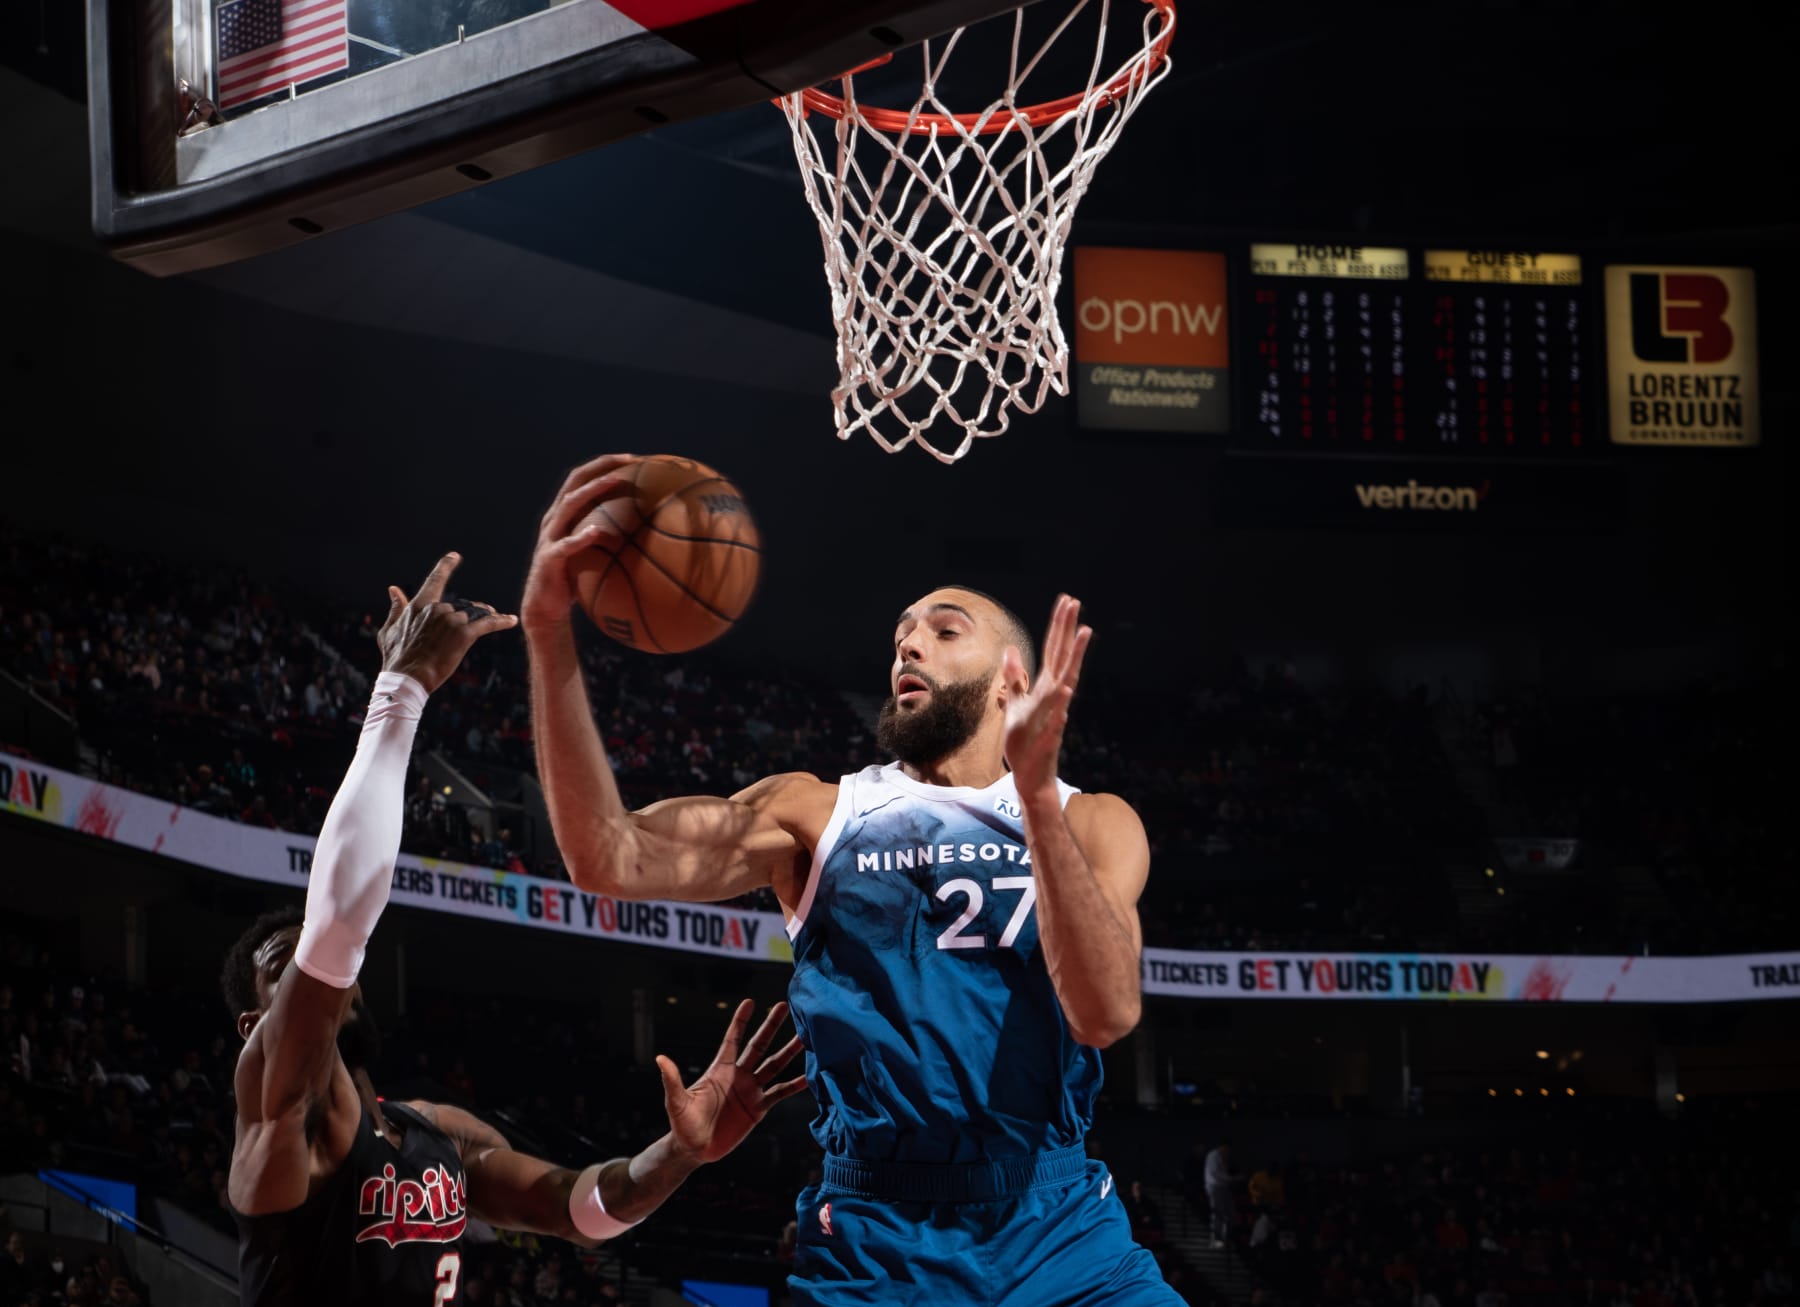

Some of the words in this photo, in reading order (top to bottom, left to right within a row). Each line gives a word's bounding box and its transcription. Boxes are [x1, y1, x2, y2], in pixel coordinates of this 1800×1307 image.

[1079, 296, 1223, 345] opnw
[1090, 366, 1141, 387] Office
[1142, 368, 1216, 390] Products
[1628, 373, 1742, 399] LORENTZ
[1629, 400, 1743, 428] BRUUN
[1354, 478, 1479, 512] verizon
[438, 873, 518, 910] TICKETS
[527, 884, 575, 925] GET
[580, 894, 669, 938] YOURS
[676, 908, 761, 951] TODAY
[934, 875, 1038, 951] 27
[1149, 960, 1229, 985] TICKETS
[1239, 959, 1291, 991] GET
[1296, 959, 1391, 993] YOURS
[1399, 962, 1490, 992] TODAY
[1750, 964, 1800, 988] TRAI
